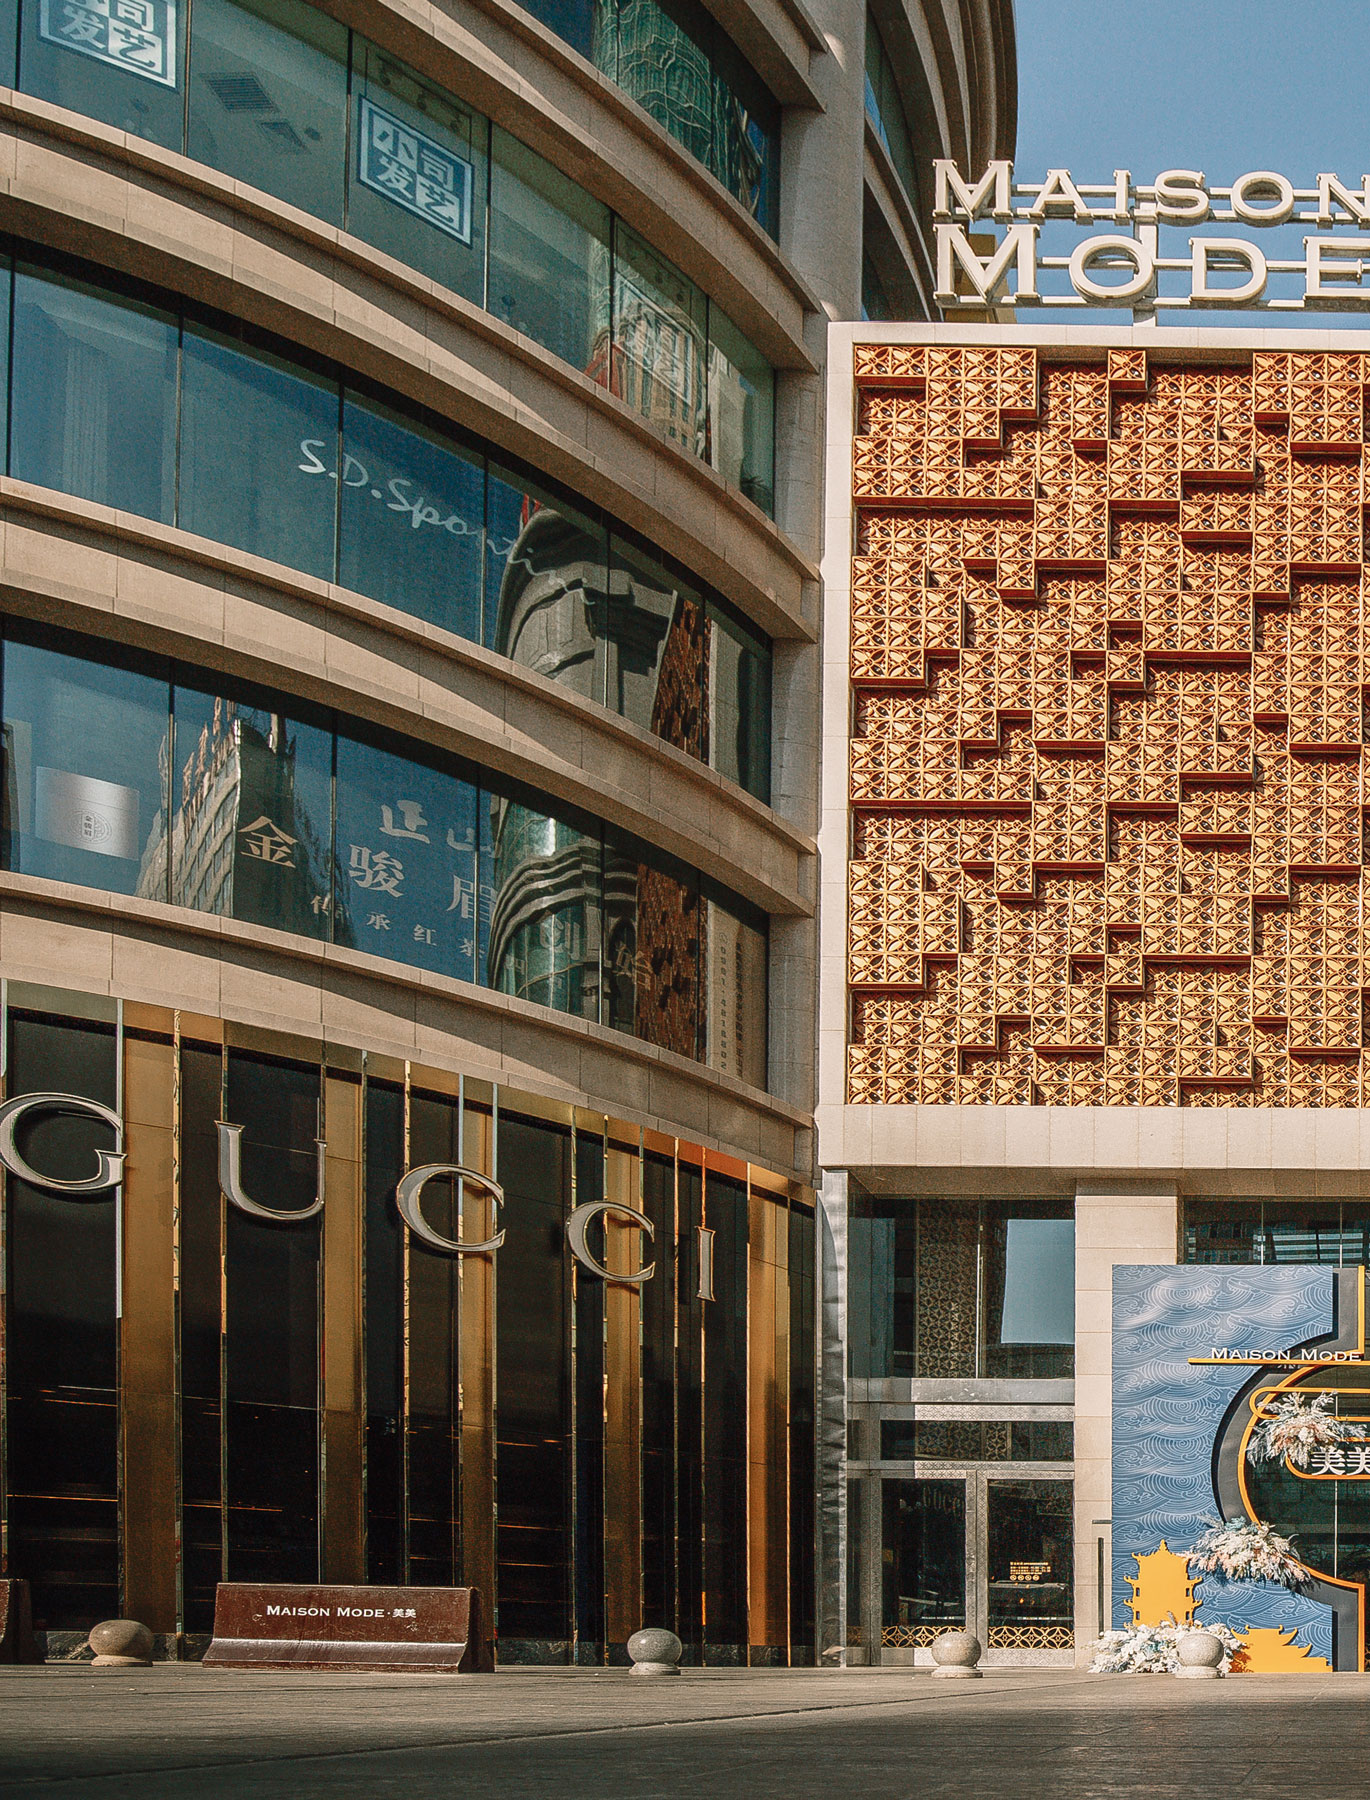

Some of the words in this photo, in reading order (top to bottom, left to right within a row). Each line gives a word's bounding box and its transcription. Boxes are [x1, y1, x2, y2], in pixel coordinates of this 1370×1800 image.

[0, 1092, 716, 1302] GUCCI
[1211, 1347, 1291, 1361] MAISON
[1301, 1349, 1361, 1362] MODE
[266, 1604, 330, 1617] MAISON
